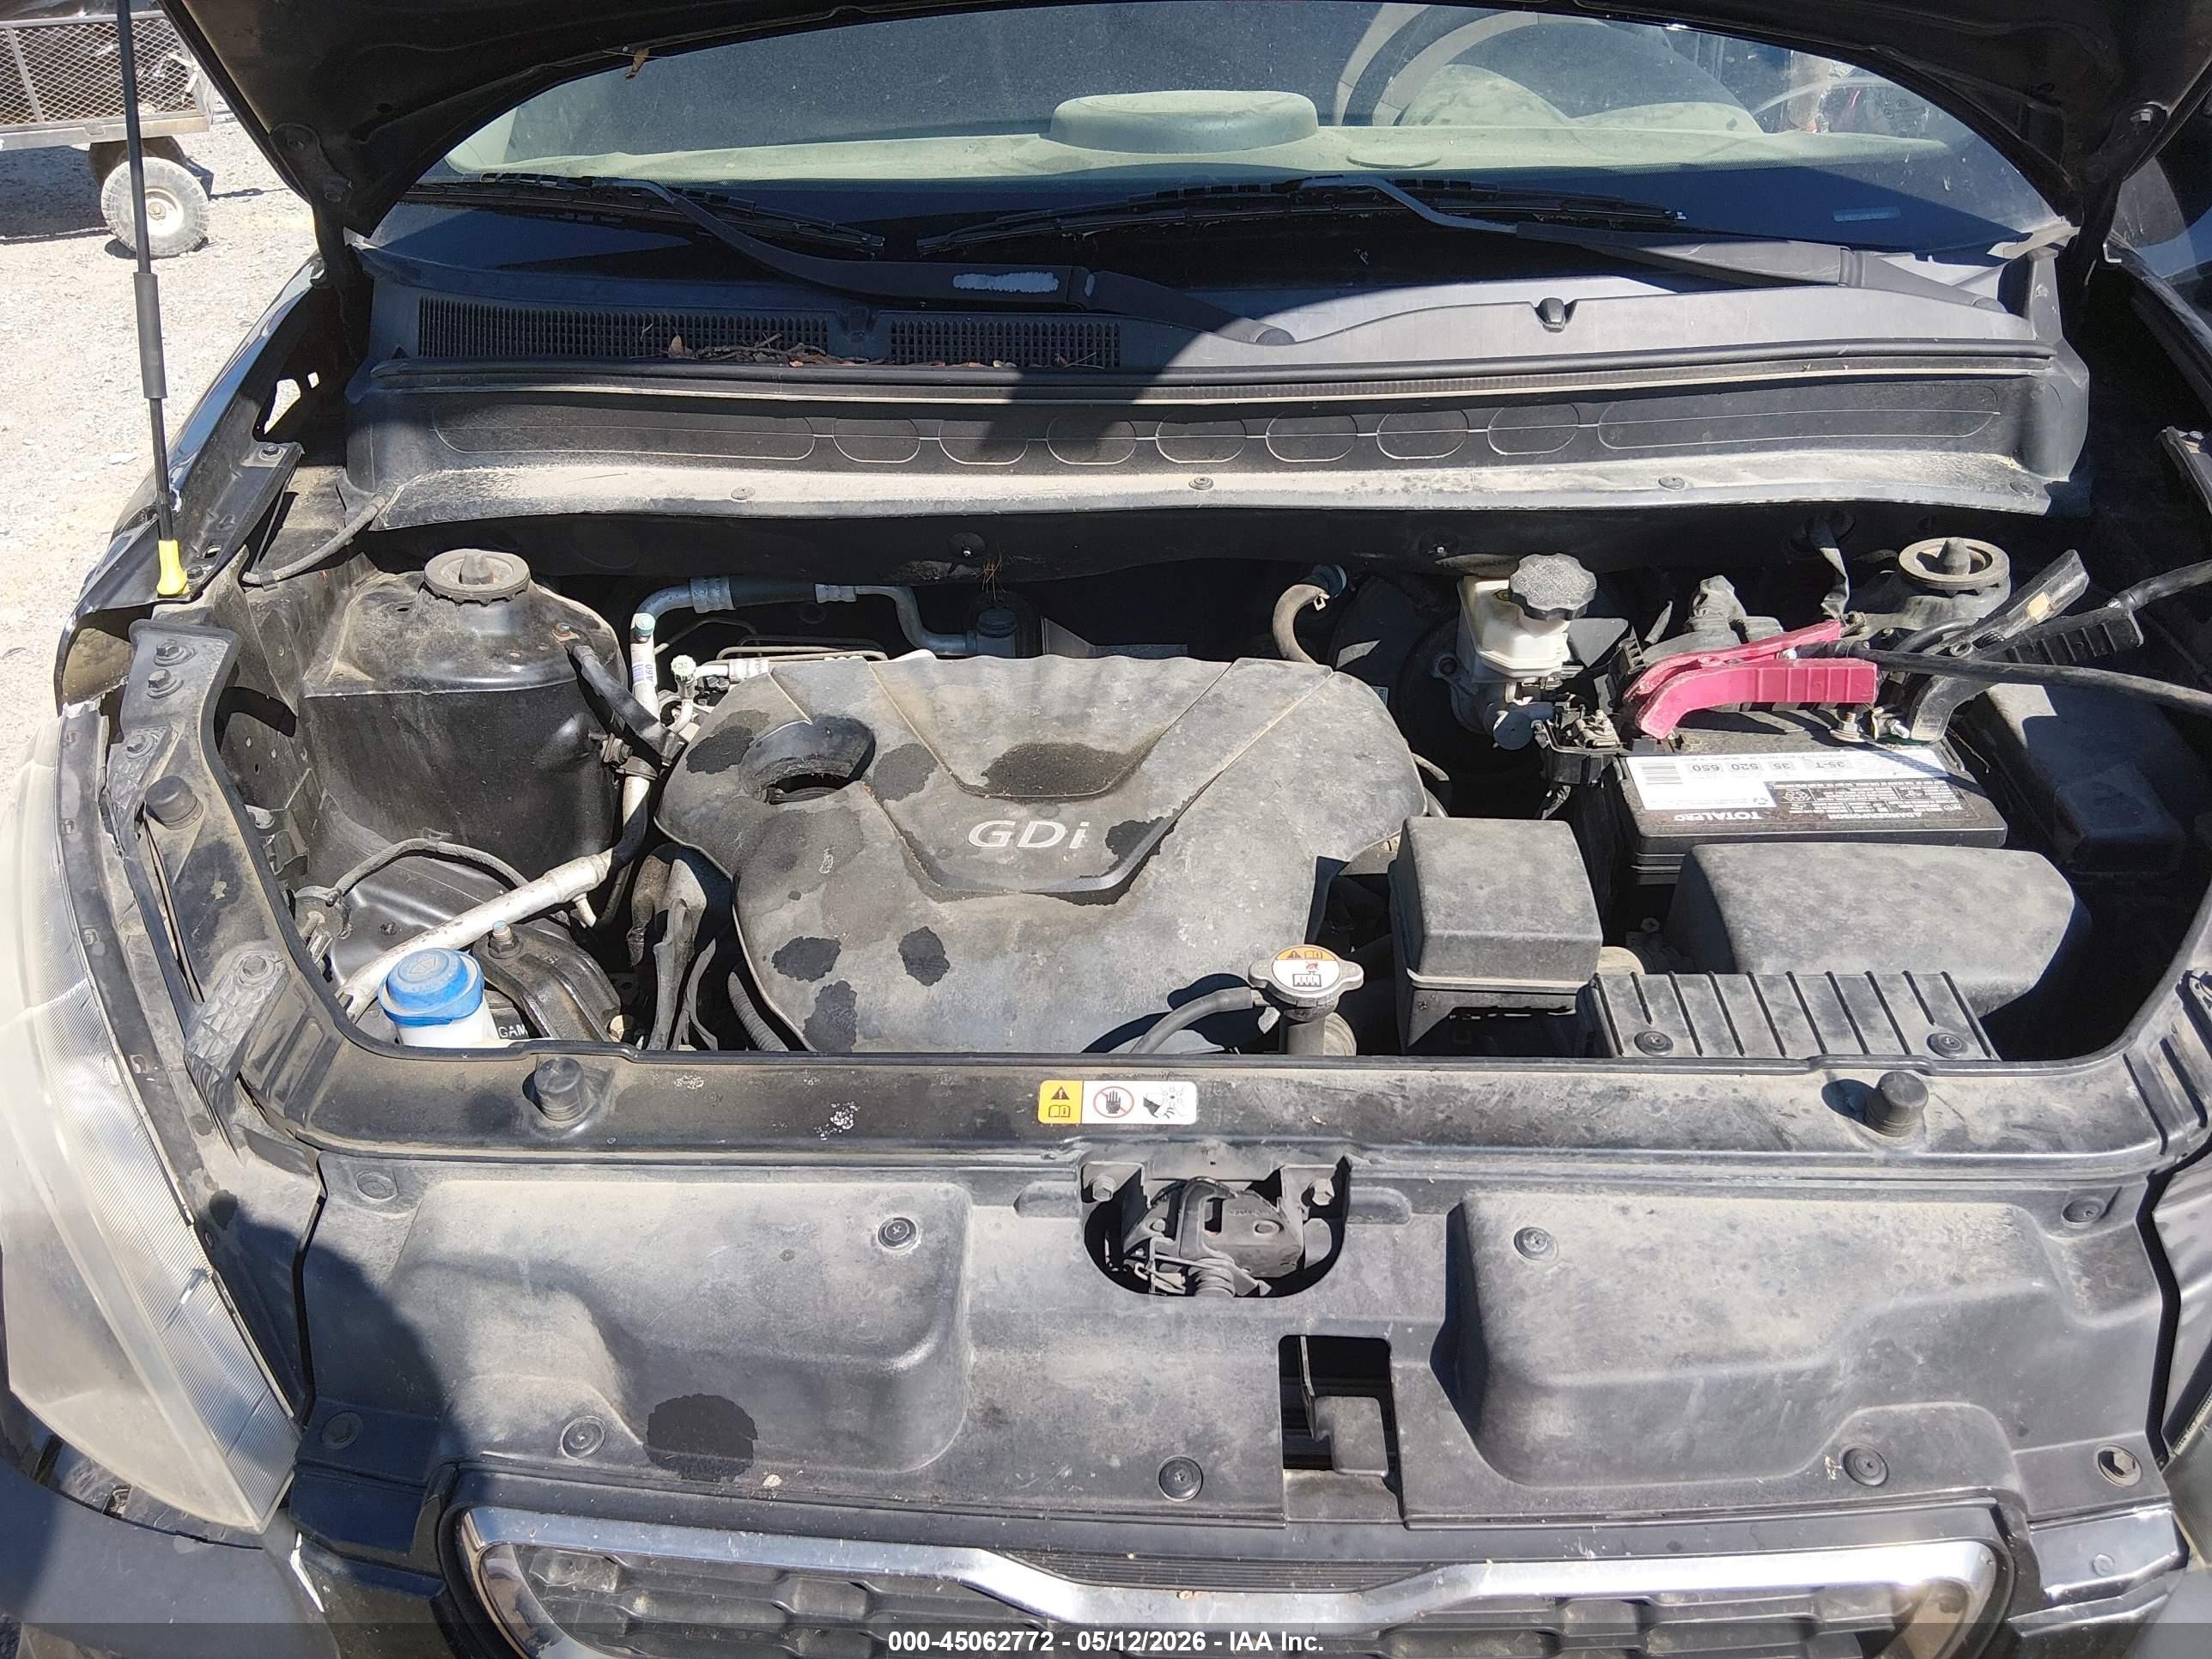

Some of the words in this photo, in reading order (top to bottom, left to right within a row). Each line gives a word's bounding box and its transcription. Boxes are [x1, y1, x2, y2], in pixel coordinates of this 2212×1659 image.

[645, 664, 653, 683] A60
[1674, 811, 1763, 822] TOTALPRO
[968, 820, 1090, 848] GDi
